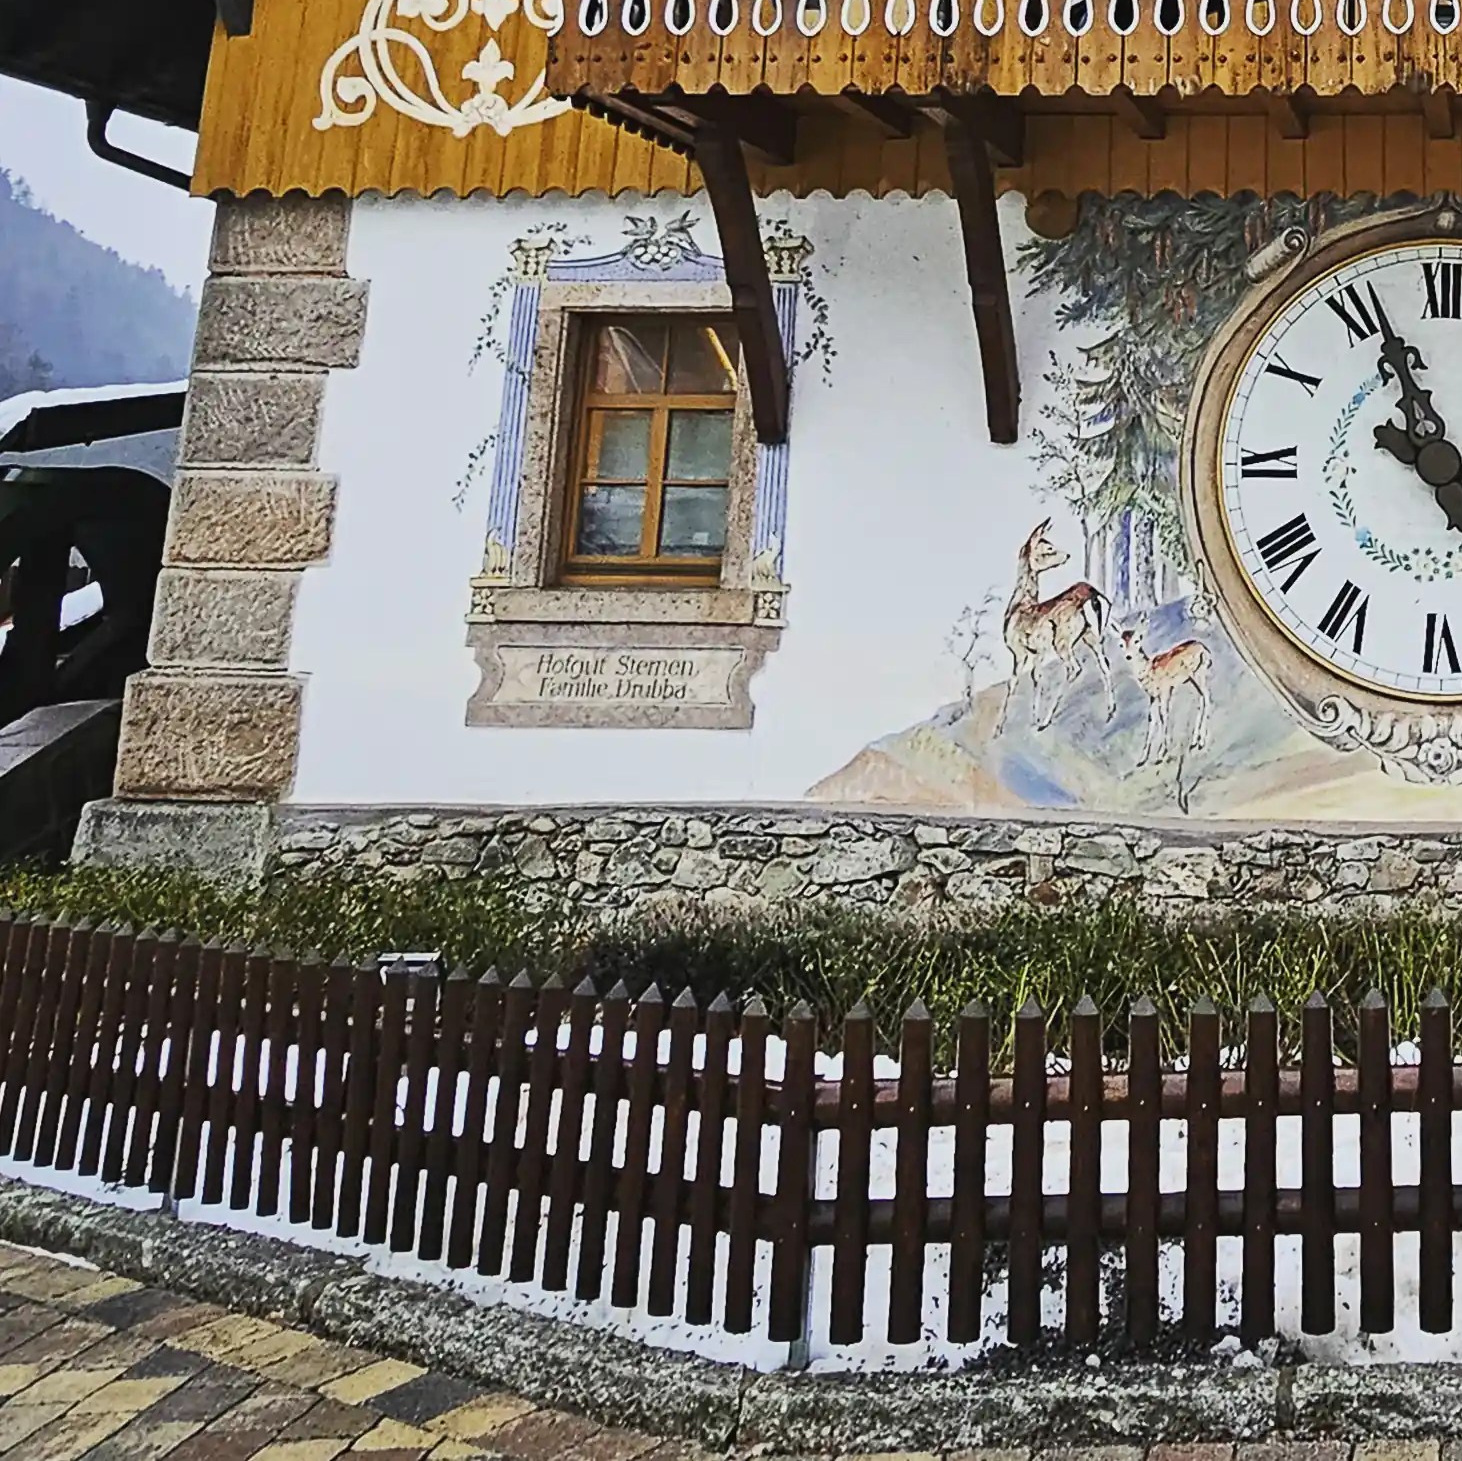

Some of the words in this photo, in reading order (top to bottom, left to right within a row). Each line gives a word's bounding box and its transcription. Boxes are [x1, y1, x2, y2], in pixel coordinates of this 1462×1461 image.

[1324, 283, 1380, 349] XI
[1420, 262, 1462, 320] XII
[1264, 352, 1323, 398] X
[1241, 445, 1298, 479] IX
[1256, 512, 1323, 595] VIII
[1317, 579, 1370, 656] VII
[1422, 613, 1462, 675] VI
[536, 653, 606, 680] Hofgut
[539, 676, 608, 698] Familie
[615, 677, 687, 700] Drubba
